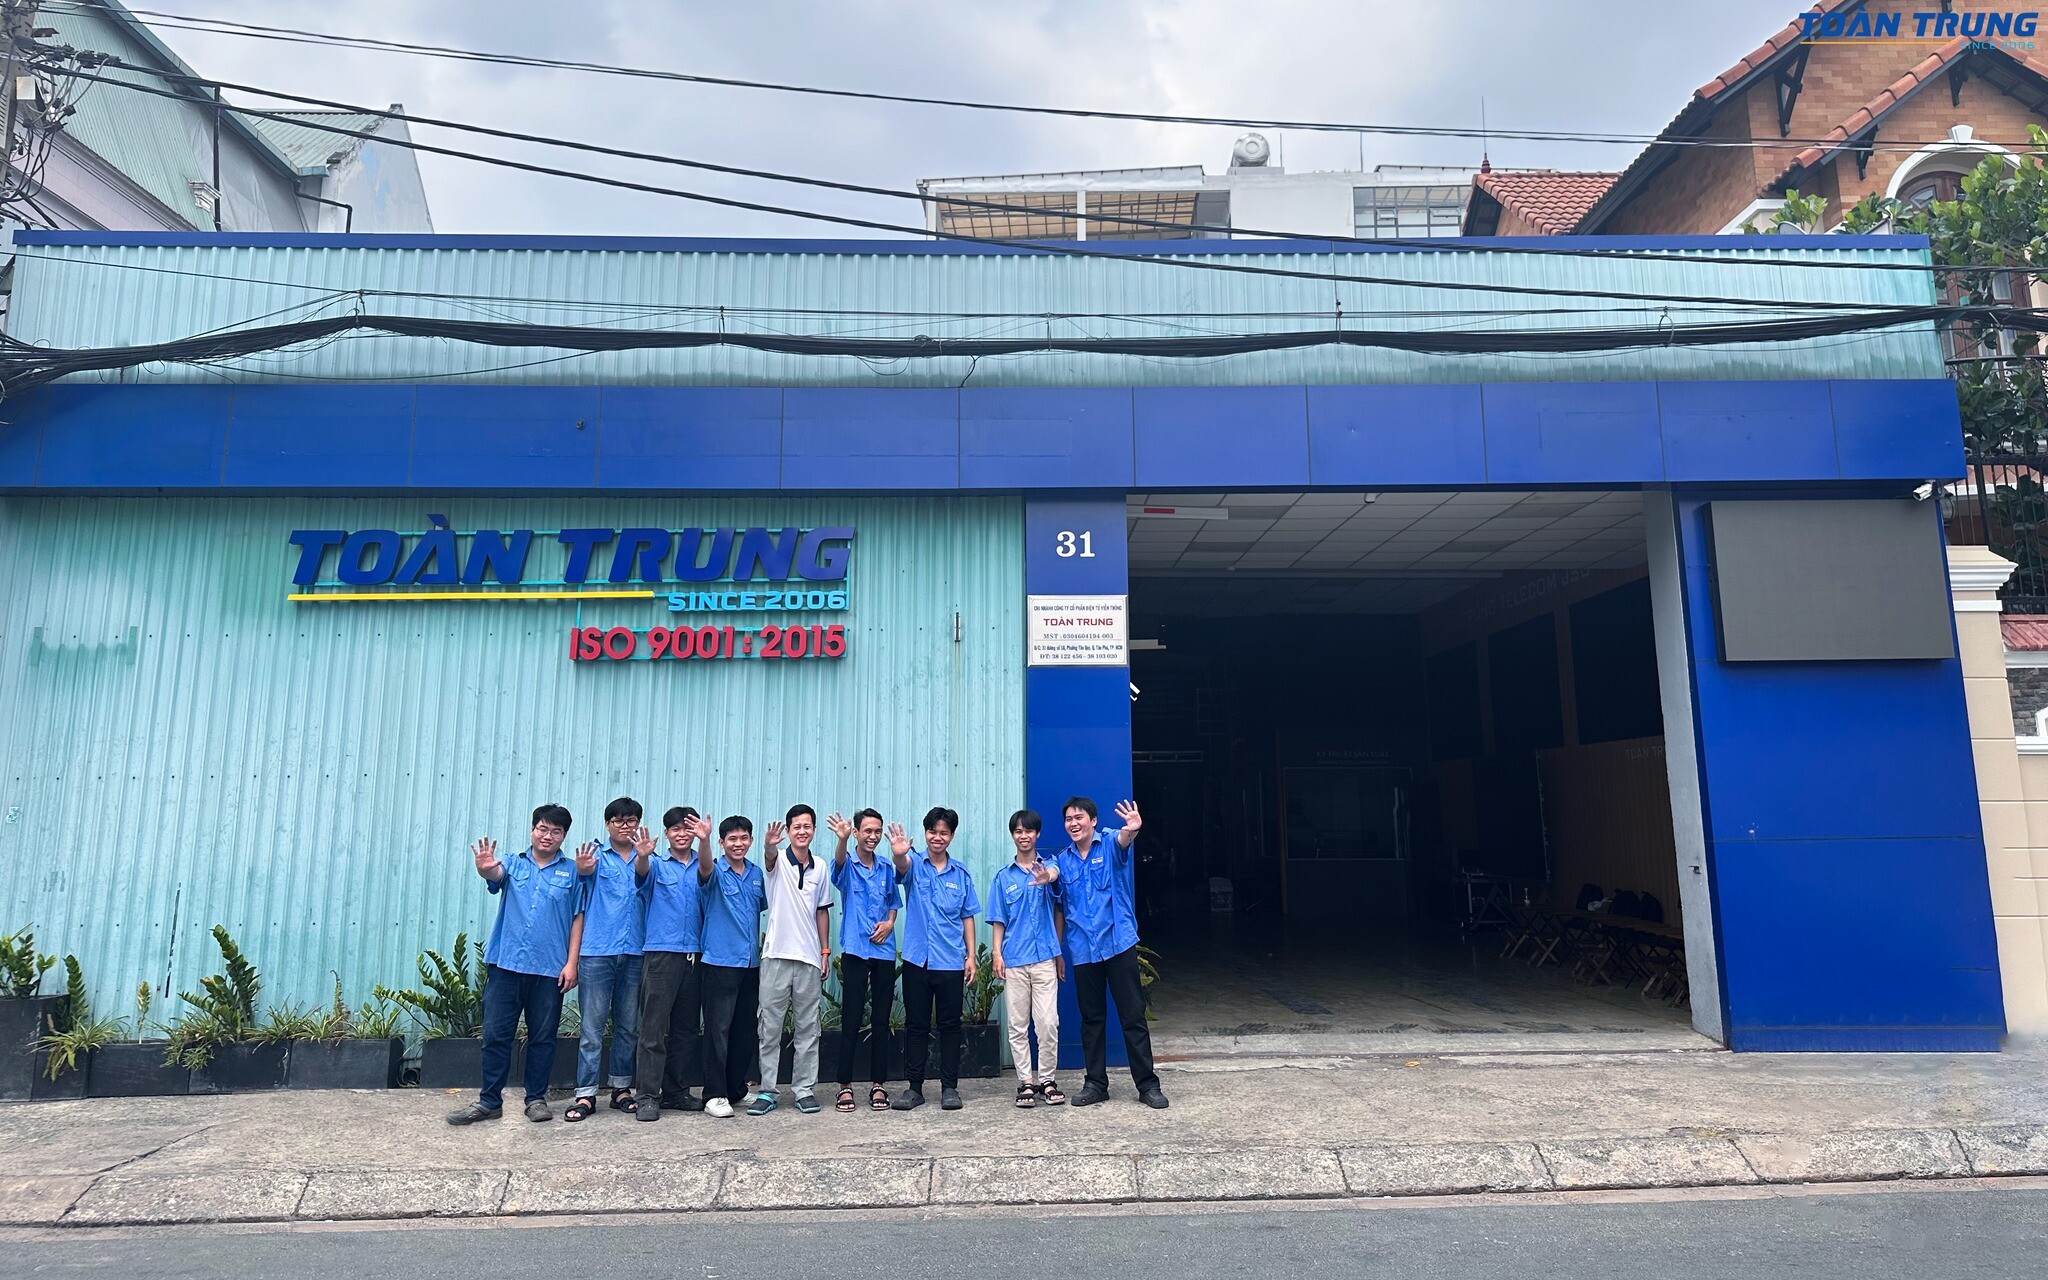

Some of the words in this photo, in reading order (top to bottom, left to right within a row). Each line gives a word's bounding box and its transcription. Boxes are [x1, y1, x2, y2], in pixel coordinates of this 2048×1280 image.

[289, 514, 534, 586] TOÀN
[557, 527, 856, 584] TRUNG
[1056, 531, 1095, 558] 31
[668, 590, 757, 612] SINCE
[764, 590, 847, 611] 2006
[1499, 573, 1557, 611] TELECOM
[1043, 616, 1074, 626] TOÀN
[1076, 618, 1113, 626] TRUNG
[569, 626, 638, 662] ISO
